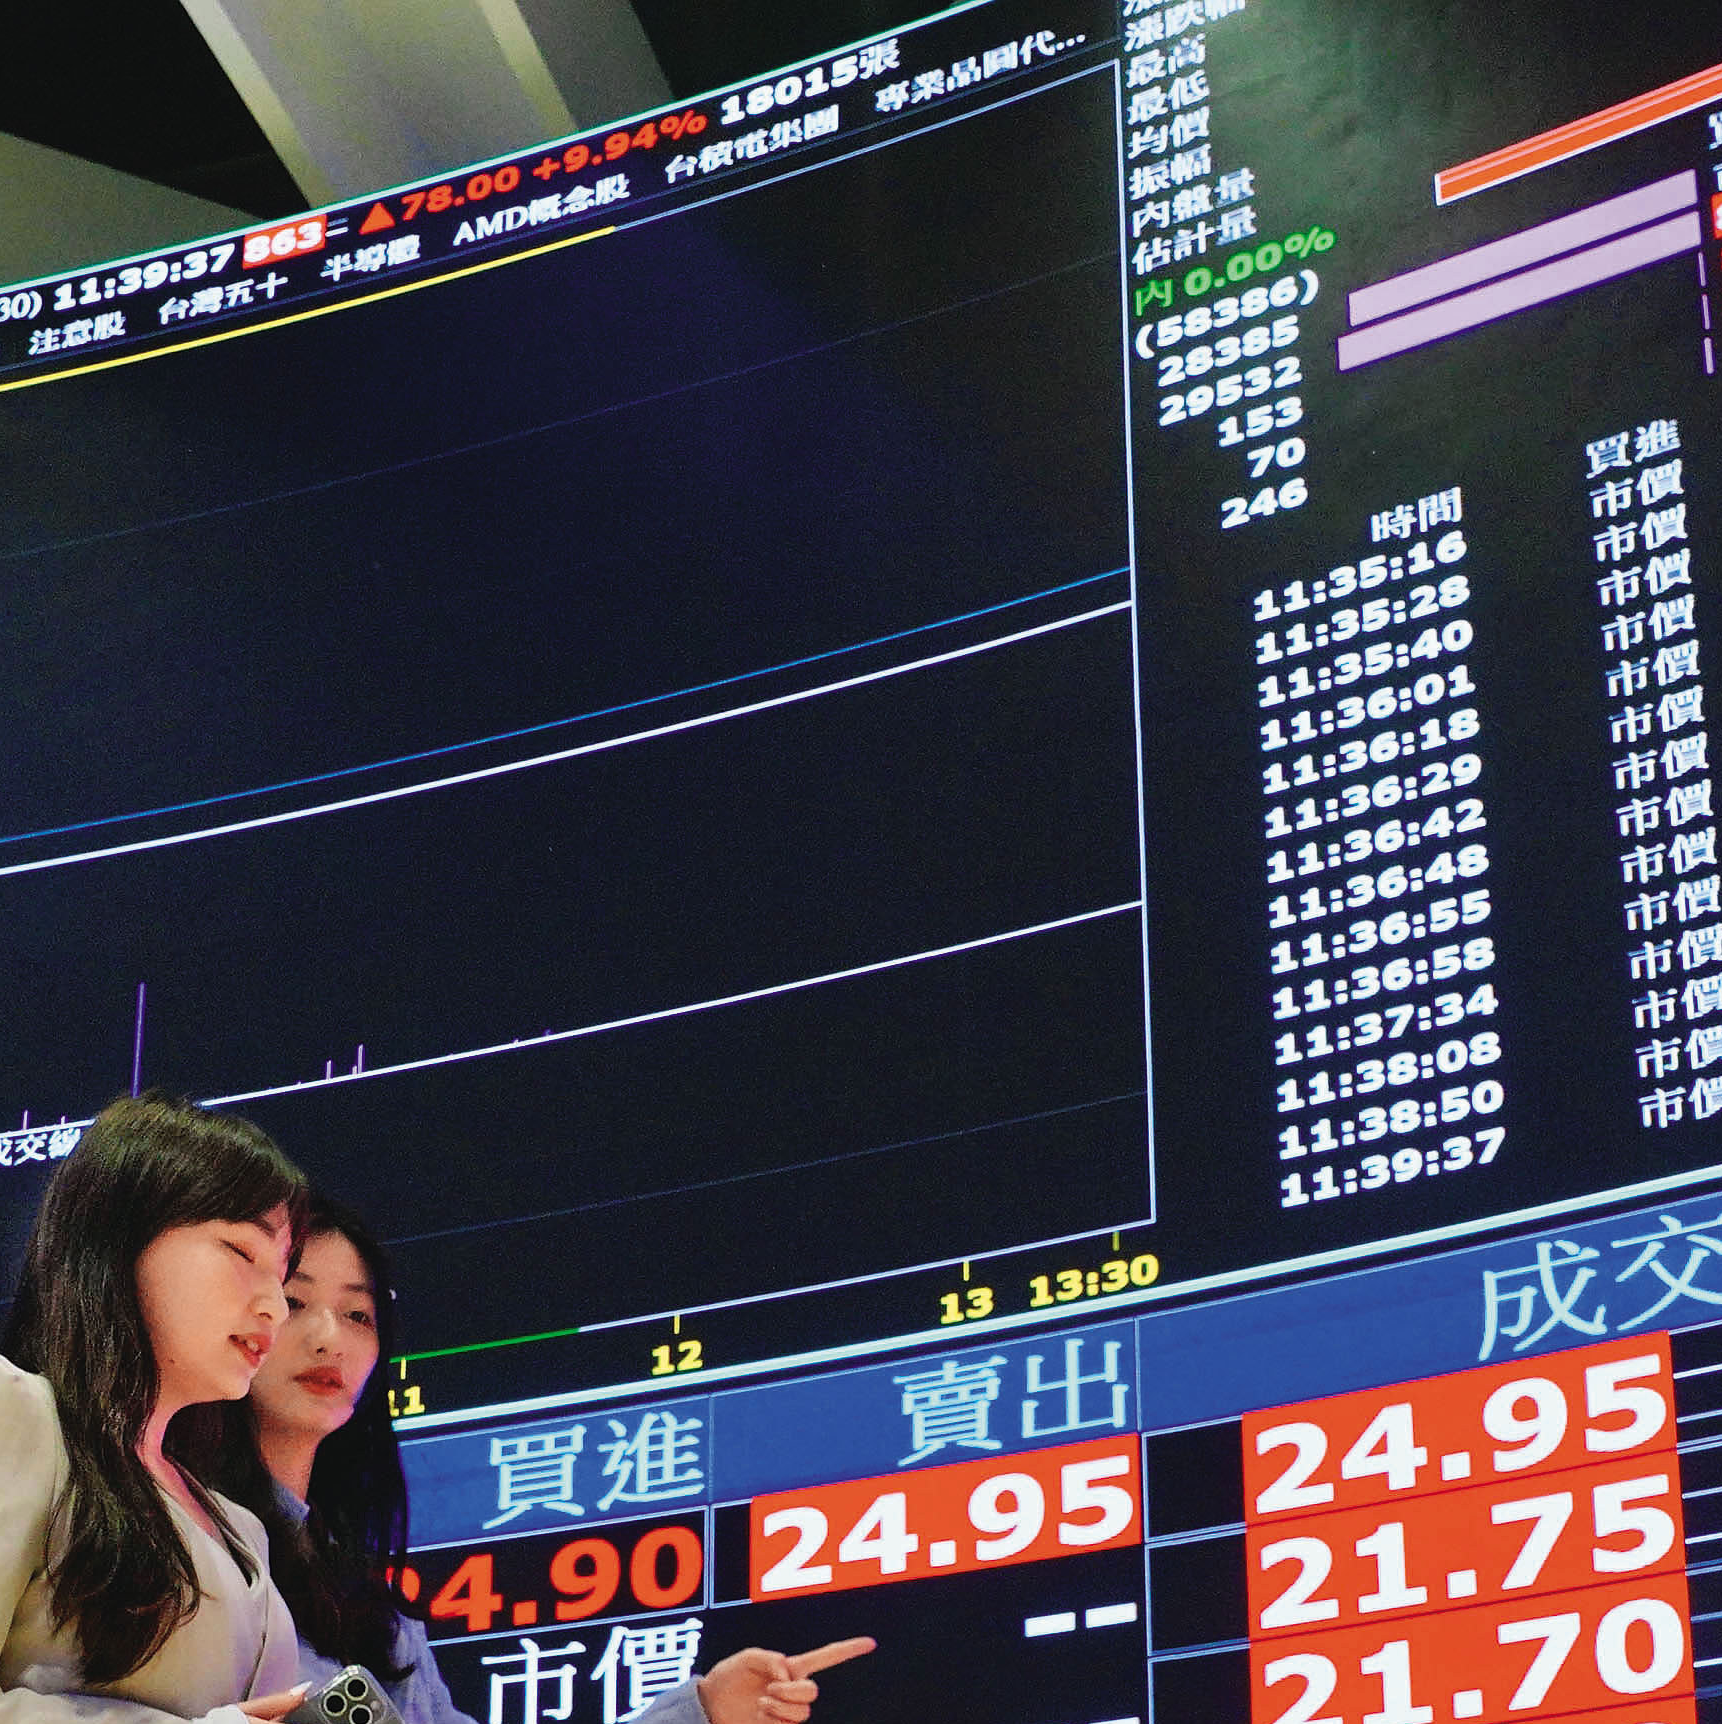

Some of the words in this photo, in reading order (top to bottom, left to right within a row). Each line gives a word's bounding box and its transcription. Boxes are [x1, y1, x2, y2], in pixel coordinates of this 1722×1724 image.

[54, 243, 235, 310] 11:39:37
[244, 222, 322, 262] 863
[402, 166, 520, 220] 78.00
[533, 110, 707, 180] +9.94%
[1184, 224, 1337, 296] 0.00%
[1158, 315, 1299, 386] 28385
[1159, 356, 1302, 426] 29532
[1219, 396, 1303, 447] 153
[1222, 478, 1308, 528] 246
[1254, 530, 1467, 621] 11:35:16
[1257, 575, 1470, 664] 11:35:28
[1261, 665, 1475, 750] 11:36:01
[1265, 753, 1481, 838] 11:36:29
[1269, 844, 1489, 928] 11:36:48
[1275, 984, 1498, 1065] 11:37:34
[1279, 1080, 1504, 1159] 11:38:50
[1281, 1127, 1505, 1207] 11:39:37
[941, 1288, 993, 1322] 13
[1031, 1255, 1158, 1306] 13:30
[653, 1341, 702, 1374] 12
[893, 1338, 1129, 1466] 賣出
[1257, 1354, 1666, 1514] 24.95
[482, 1411, 709, 1529] 買進
[761, 1455, 1133, 1592] 24.95
[1261, 1474, 1674, 1629] 21.75
